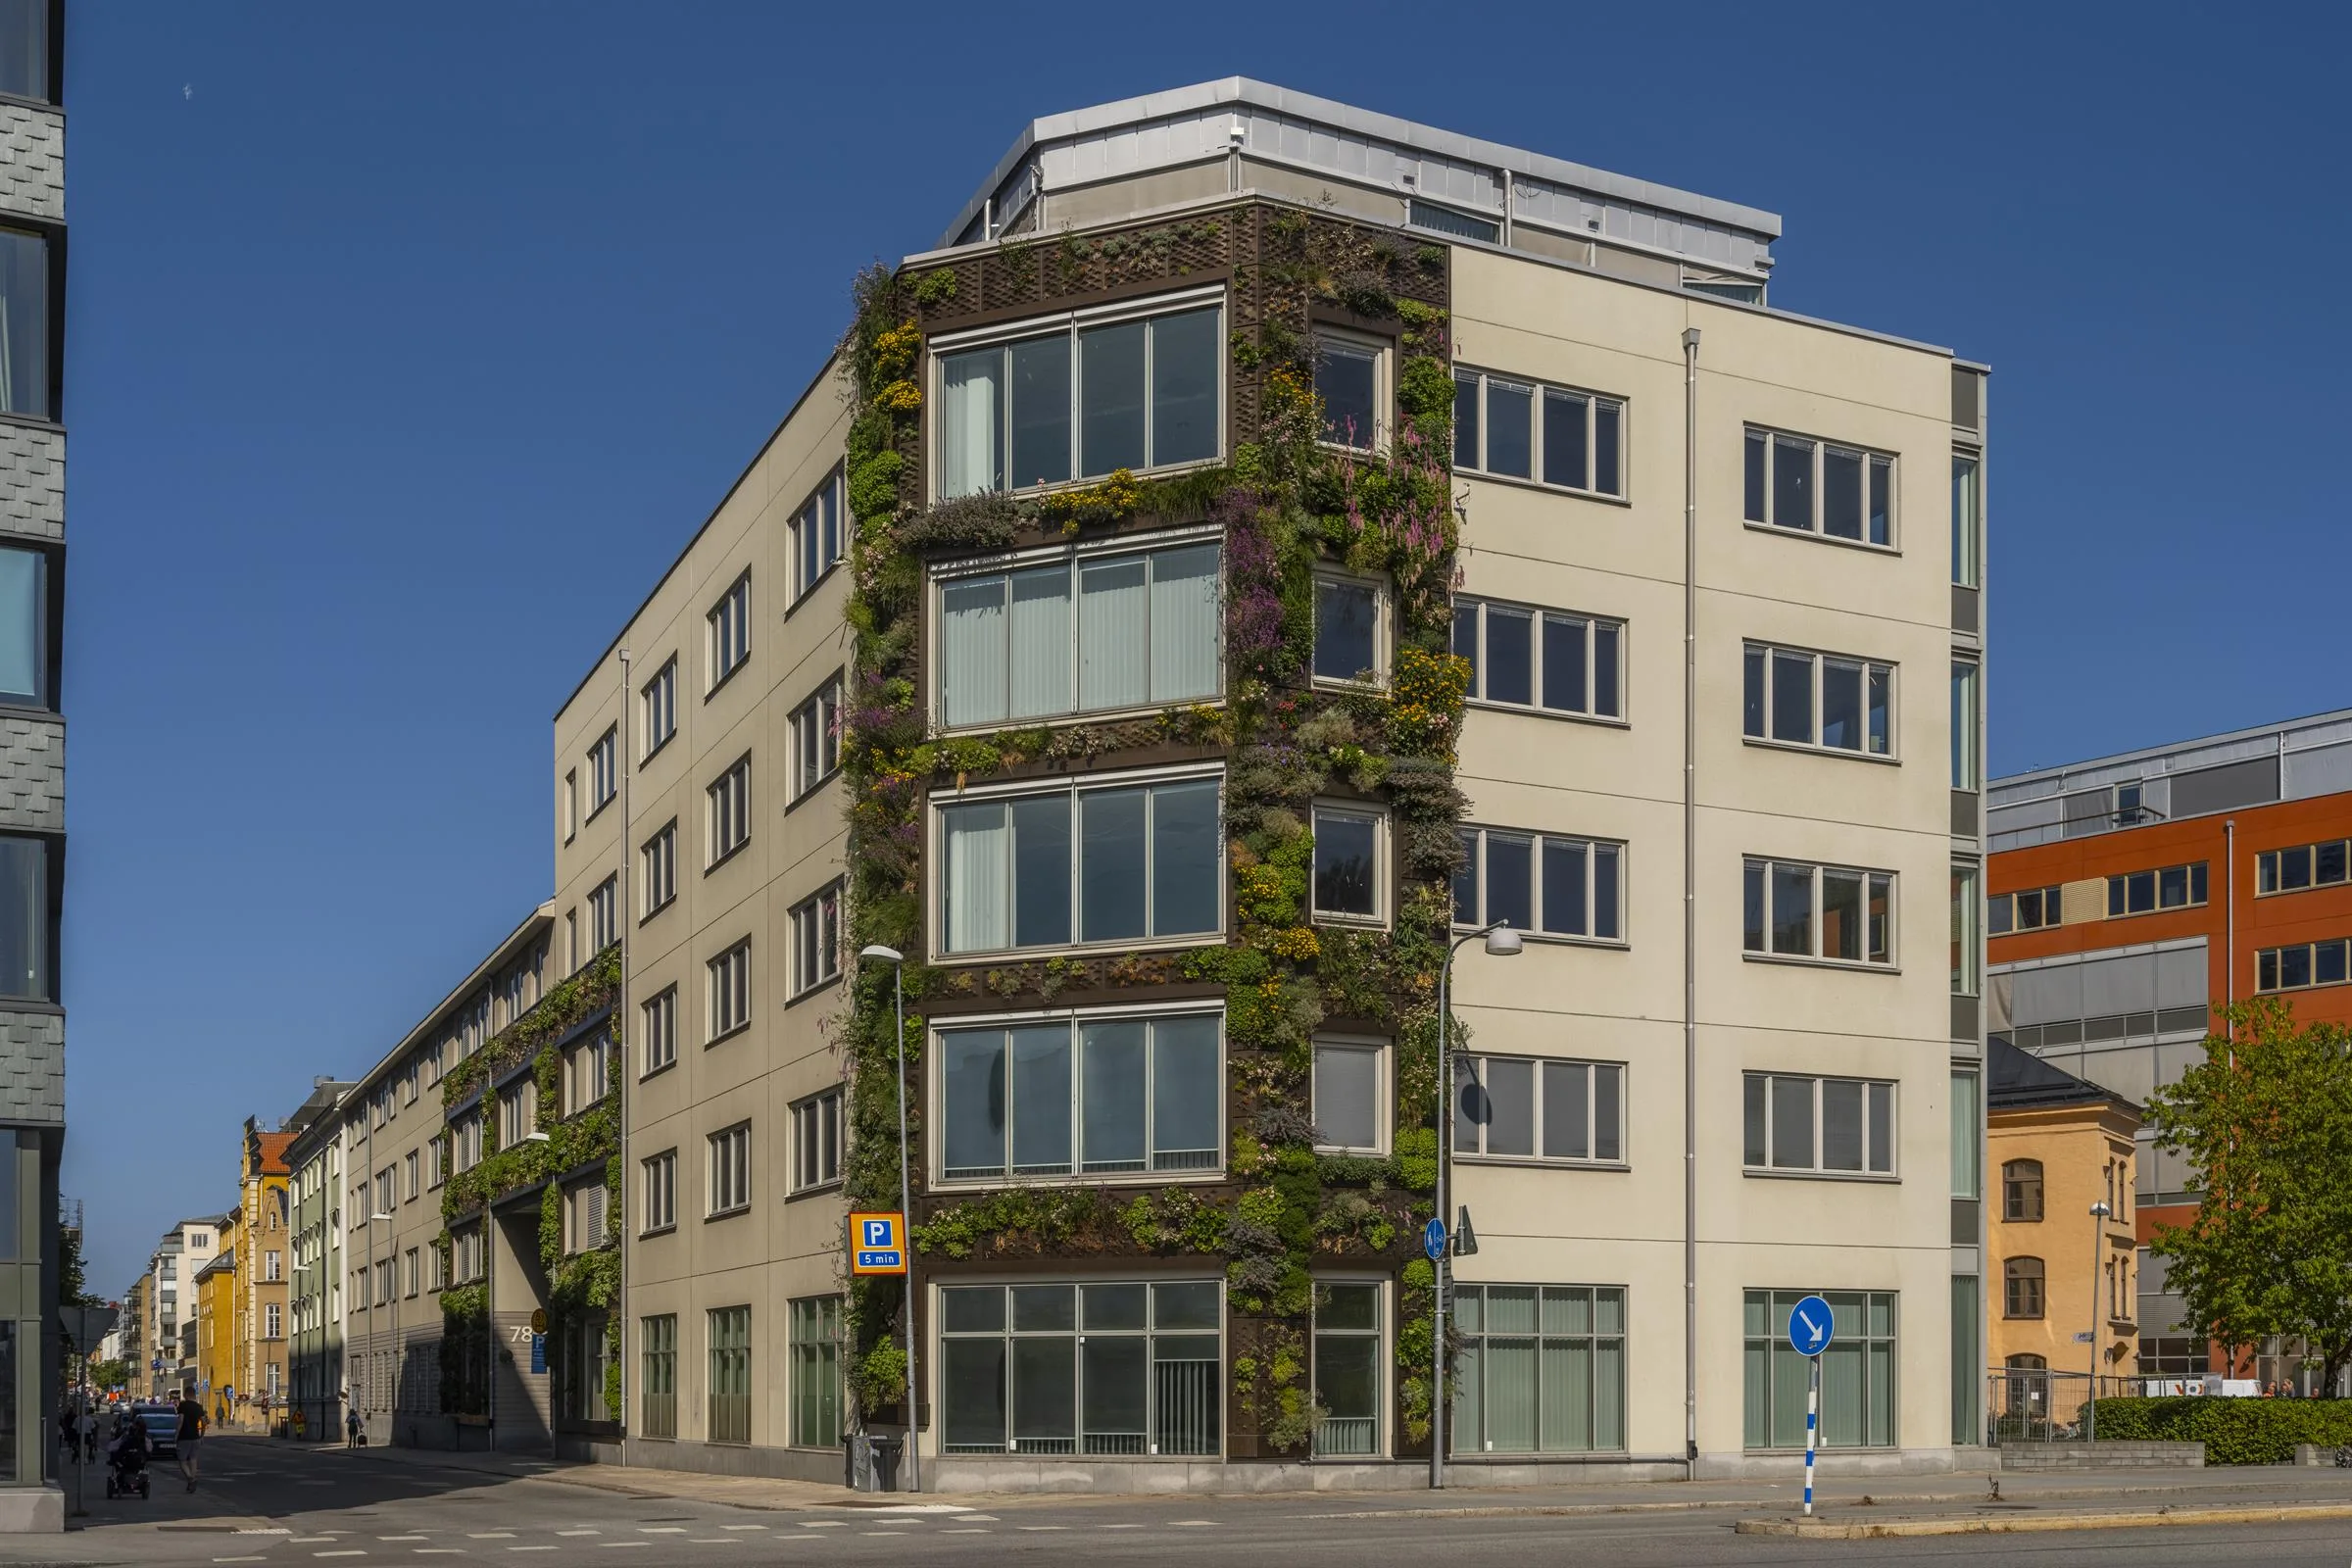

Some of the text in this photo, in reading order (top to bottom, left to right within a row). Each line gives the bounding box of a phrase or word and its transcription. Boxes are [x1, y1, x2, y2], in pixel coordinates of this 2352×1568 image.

[870, 1222, 884, 1245] P
[864, 1253, 895, 1263] 5 min
[535, 1336, 545, 1348] P
